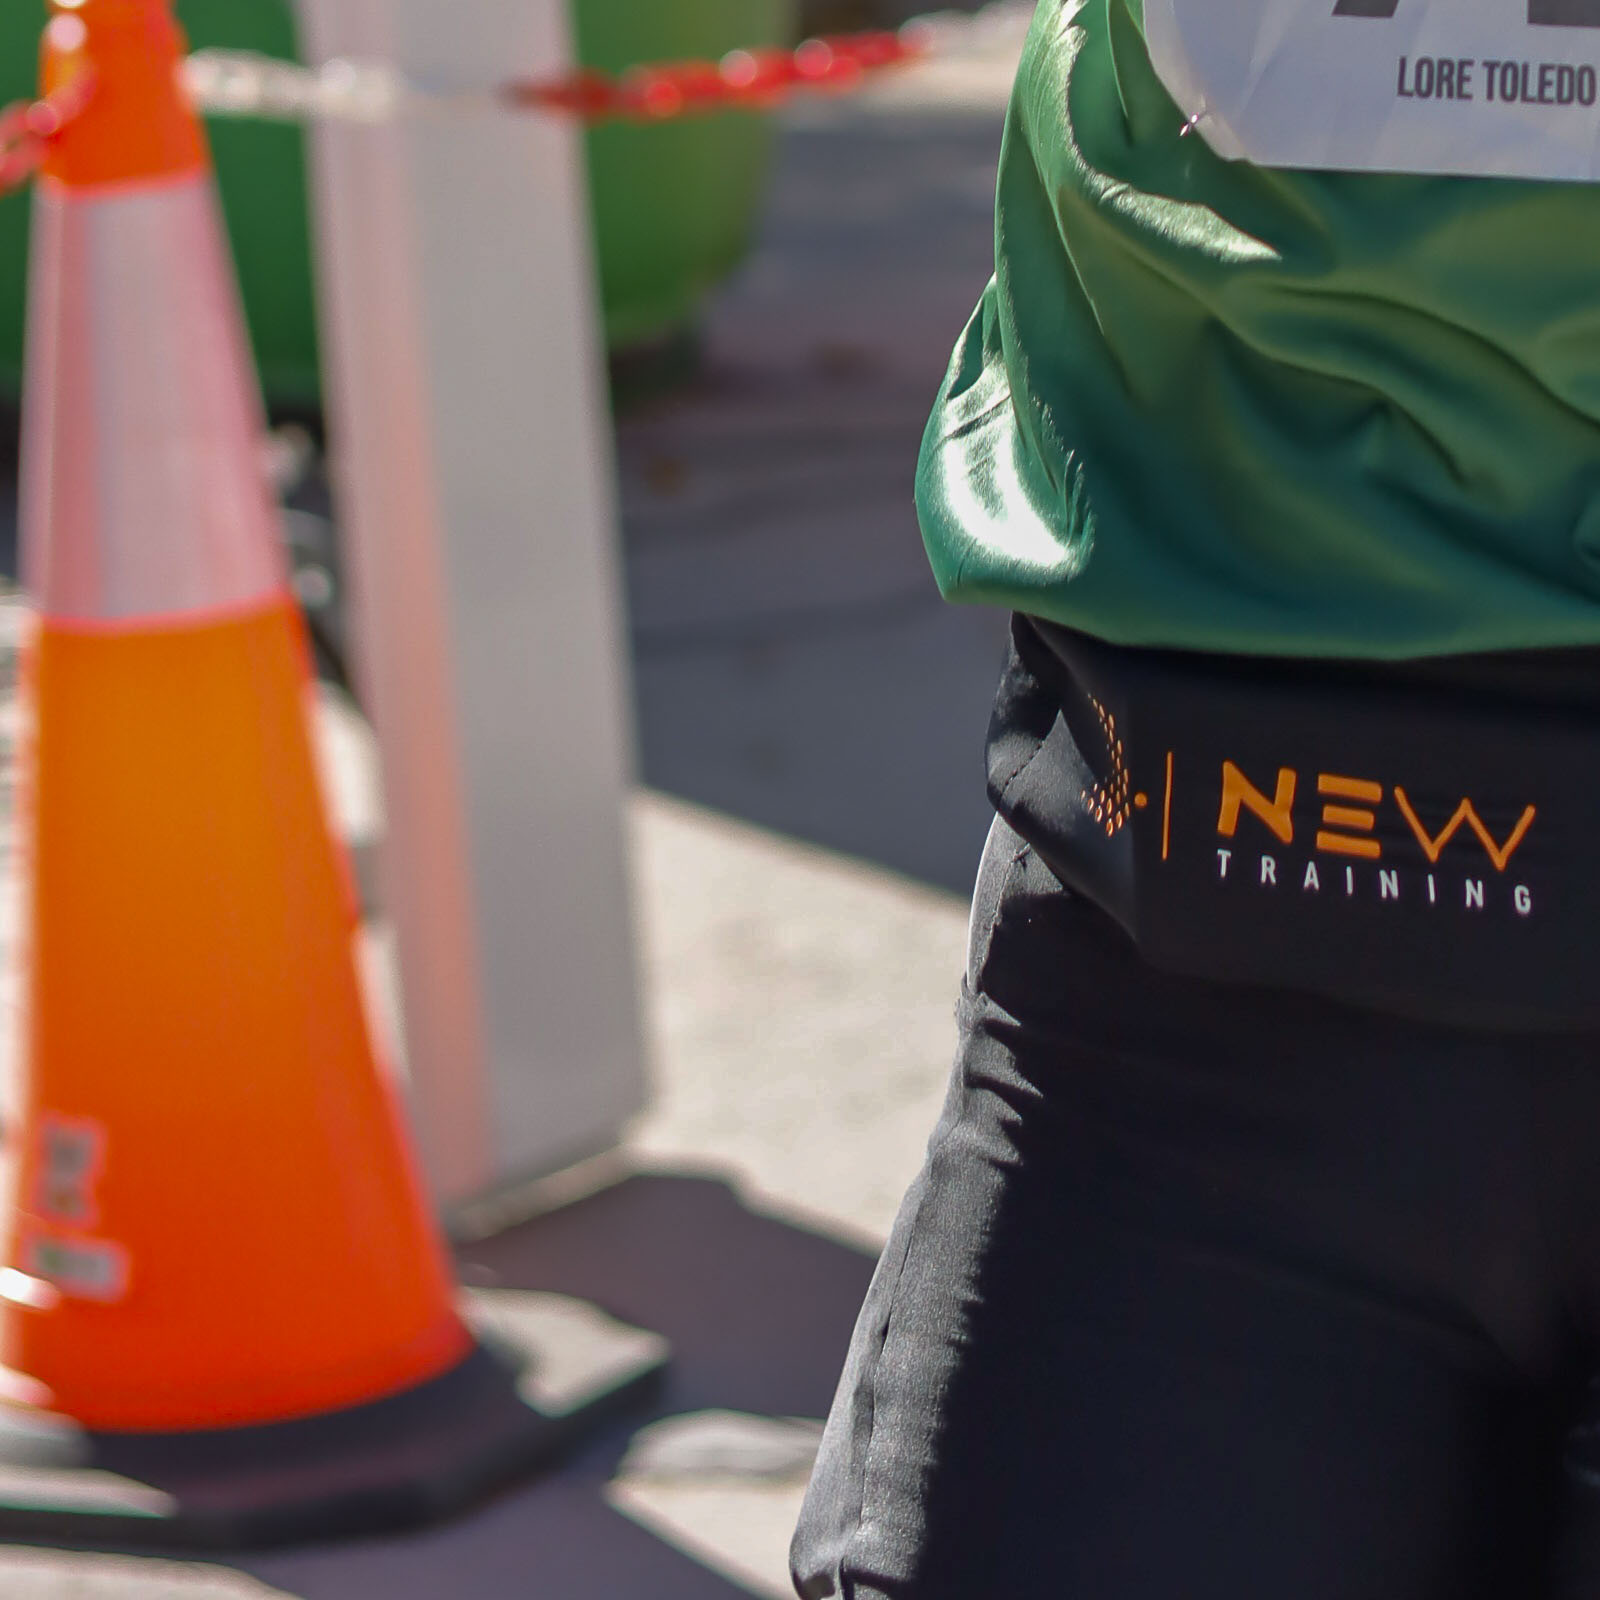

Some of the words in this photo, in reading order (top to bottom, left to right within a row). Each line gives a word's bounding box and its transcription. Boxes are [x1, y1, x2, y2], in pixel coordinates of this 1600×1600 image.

[1397, 55, 1475, 101] LORE
[1481, 58, 1598, 108] TOLEDO
[1217, 759, 1537, 872] NEW
[1216, 848, 1533, 916] TRAINING
